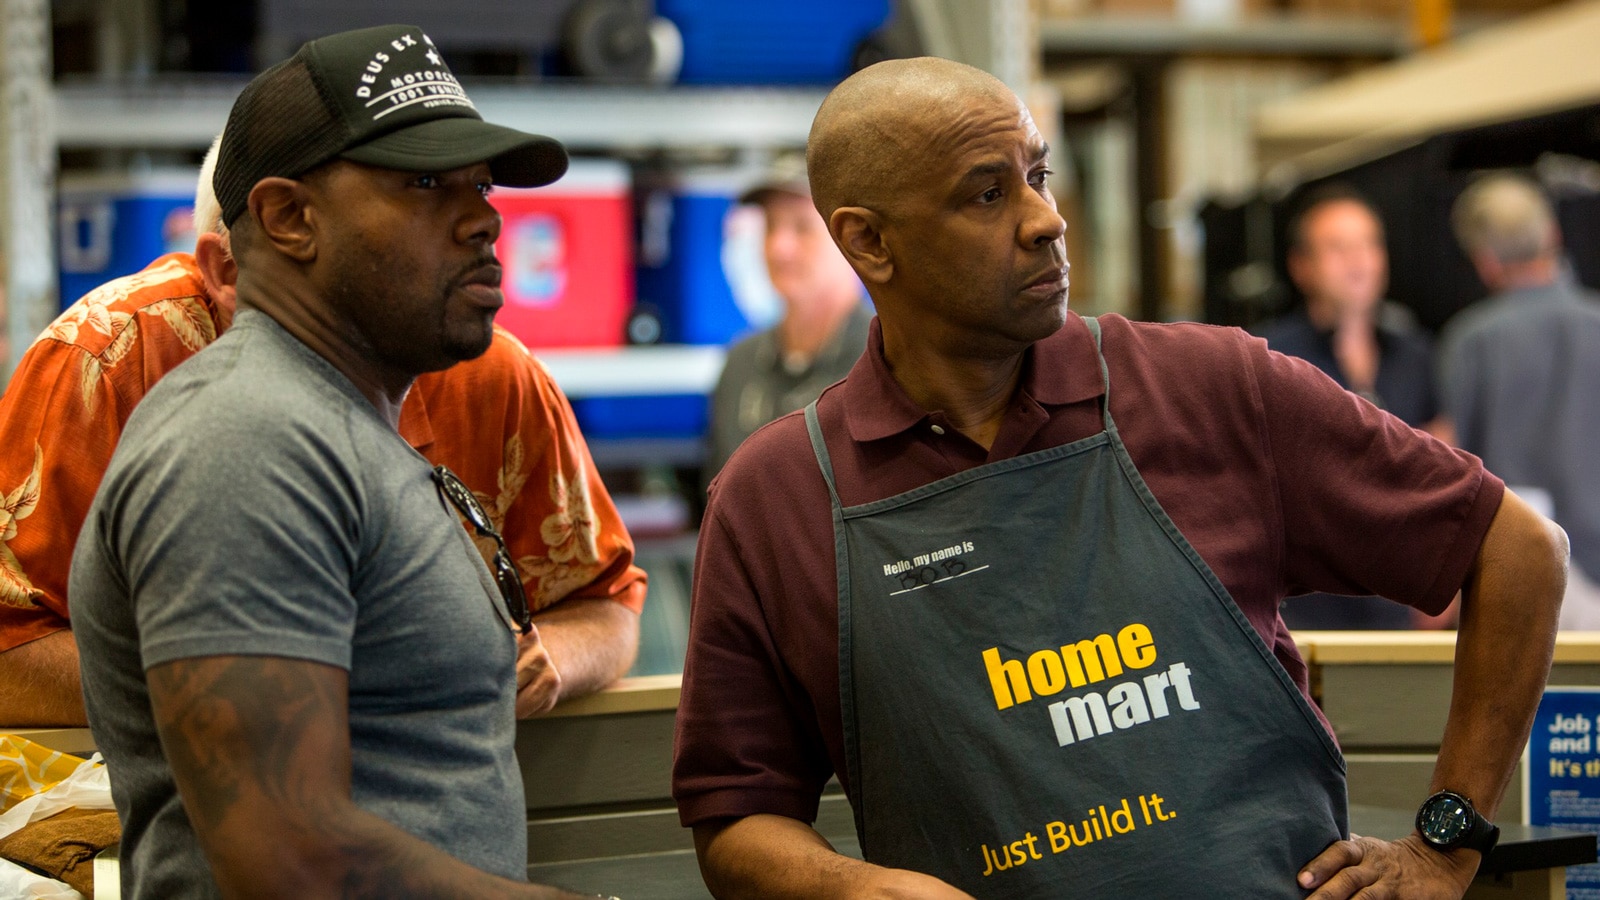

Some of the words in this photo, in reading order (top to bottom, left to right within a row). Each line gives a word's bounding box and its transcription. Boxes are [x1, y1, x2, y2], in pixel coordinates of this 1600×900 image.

[356, 52, 390, 98] DEUS
[391, 34, 417, 52] EX
[389, 87, 424, 105] 1001
[883, 560, 914, 576] Hello,
[913, 554, 930, 567] my
[931, 545, 962, 562] name
[962, 541, 975, 553] is
[895, 558, 966, 590] BOB
[981, 623, 1157, 711] home
[1048, 662, 1201, 747] mart
[1548, 713, 1591, 735] Job
[1549, 734, 1591, 754] and
[1549, 758, 1582, 778] It's
[981, 832, 1043, 877] Just
[1045, 798, 1136, 854] Build
[1138, 793, 1177, 826] It.
